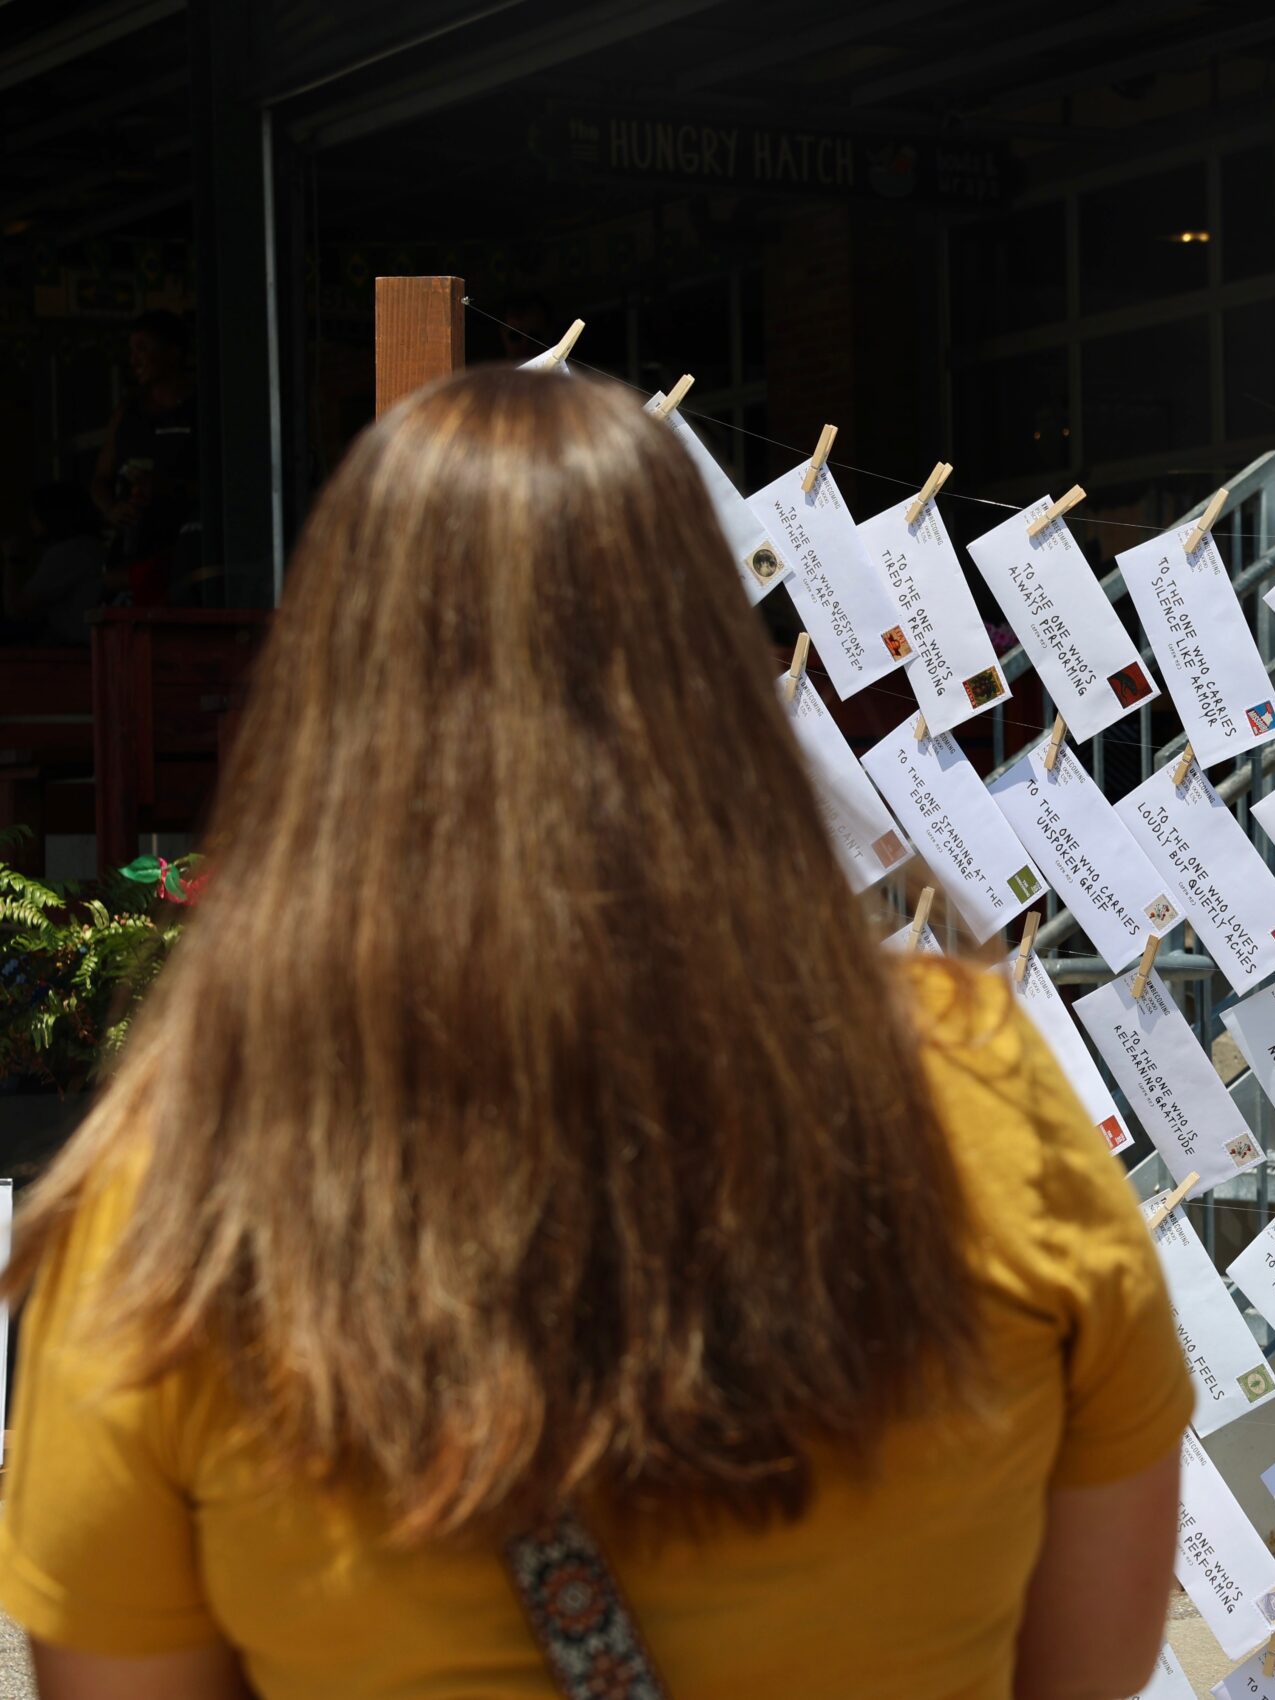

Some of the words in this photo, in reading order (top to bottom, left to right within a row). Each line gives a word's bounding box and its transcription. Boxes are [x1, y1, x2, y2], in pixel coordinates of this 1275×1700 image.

[609, 119, 739, 177] HUNGRY
[754, 131, 854, 186] HATCH
[774, 500, 801, 551] WHETHER
[800, 554, 818, 582] THEY
[815, 587, 830, 607] ARE
[787, 505, 797, 520] TO
[795, 523, 810, 544] THE
[807, 549, 822, 569] ONE
[819, 573, 834, 597] WHO
[831, 600, 864, 656] QUESTIONS
[896, 553, 907, 571] TO
[904, 575, 920, 602] THE
[916, 608, 933, 632] ONE
[929, 638, 953, 680] WHO'S
[881, 549, 902, 587] TIRED
[898, 594, 912, 610] OF
[907, 616, 945, 696] PRETENDING
[1007, 566, 1042, 615] ALWAYS
[1038, 618, 1087, 696] PERFORMING
[1022, 562, 1035, 580] TO
[1033, 583, 1053, 609] THE
[1050, 615, 1070, 639] ONE
[1068, 643, 1096, 684] WHO'S
[1150, 576, 1181, 632] SILENCE
[1175, 637, 1196, 668] LIKE
[1190, 675, 1218, 727] ARMOUR
[1158, 556, 1170, 574] TO
[1166, 579, 1184, 606] THE
[1178, 613, 1197, 638] ONE
[1192, 644, 1210, 675] WHO
[1205, 681, 1236, 736] CARRIES
[897, 748, 907, 764] TO
[907, 766, 925, 788] THE
[923, 792, 941, 812] ONE
[938, 814, 973, 866] STANDING
[972, 868, 986, 882] AT
[985, 885, 1003, 908] THE
[909, 788, 932, 818] EDGE
[930, 821, 944, 835] OF
[942, 840, 974, 880] CHANGE
[1190, 768, 1215, 804] UNBECOMING
[1137, 801, 1172, 846] LOUDLY
[1168, 849, 1189, 872] BUT
[1188, 878, 1227, 928] QUIETLY
[1224, 933, 1256, 974] ACHES
[1156, 806, 1168, 823] TO
[1168, 826, 1189, 852] THE
[1187, 856, 1209, 880] ONE
[1207, 884, 1228, 912] WHO
[1226, 914, 1258, 955] LOVES
[1113, 1024, 1156, 1092] RELEARNING
[1154, 1095, 1195, 1155] GRATITUDE
[1129, 1030, 1140, 1045] TO
[1139, 1048, 1157, 1071] THE
[1154, 1076, 1172, 1096] ONE
[1170, 1101, 1188, 1126] WHO
[1185, 1129, 1198, 1141] IS
